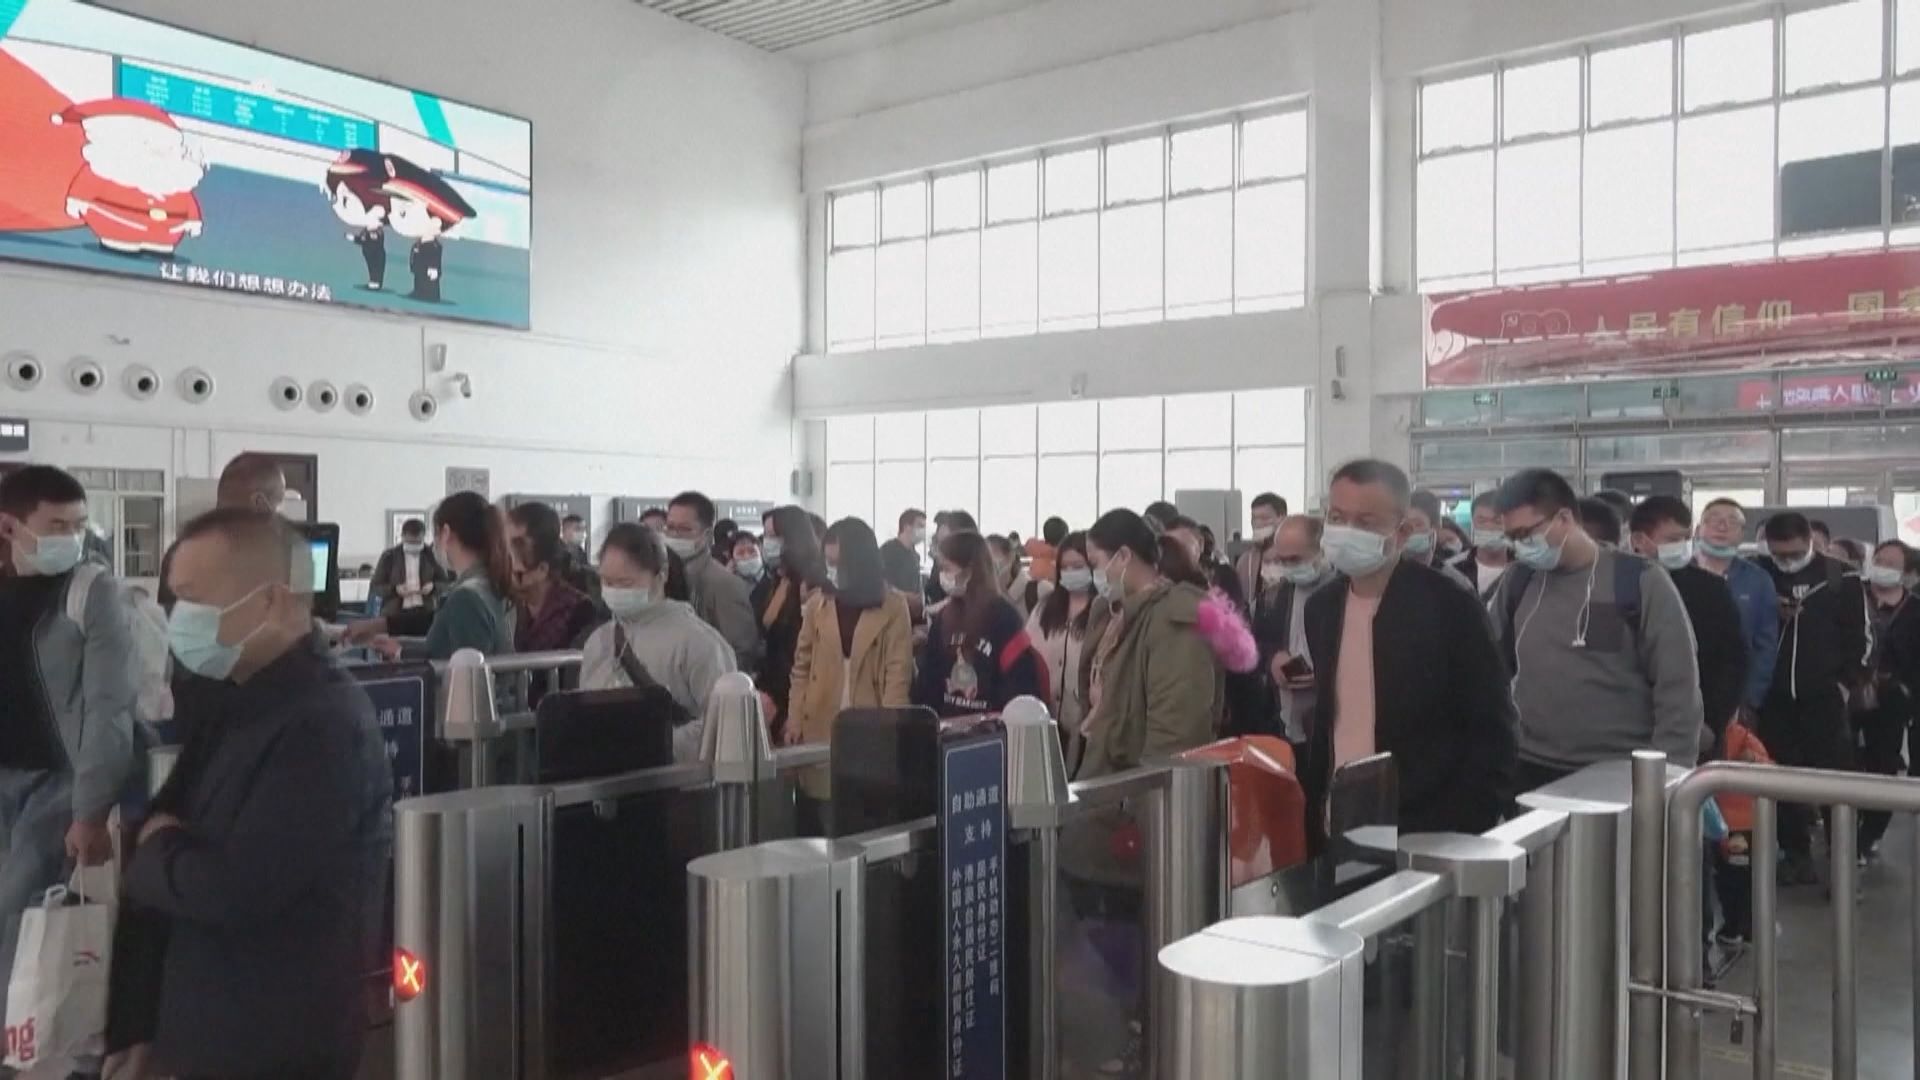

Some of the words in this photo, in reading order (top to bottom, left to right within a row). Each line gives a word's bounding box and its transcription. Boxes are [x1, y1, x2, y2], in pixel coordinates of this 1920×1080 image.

[159, 261, 332, 301] 让我们想想办法
[1588, 299, 1792, 343] 人民有信仰
[952, 785, 999, 815] 自助通道
[964, 818, 992, 845] 支持
[976, 860, 987, 962] 居民身份证
[951, 867, 963, 1078] 外国人永久居留身份证
